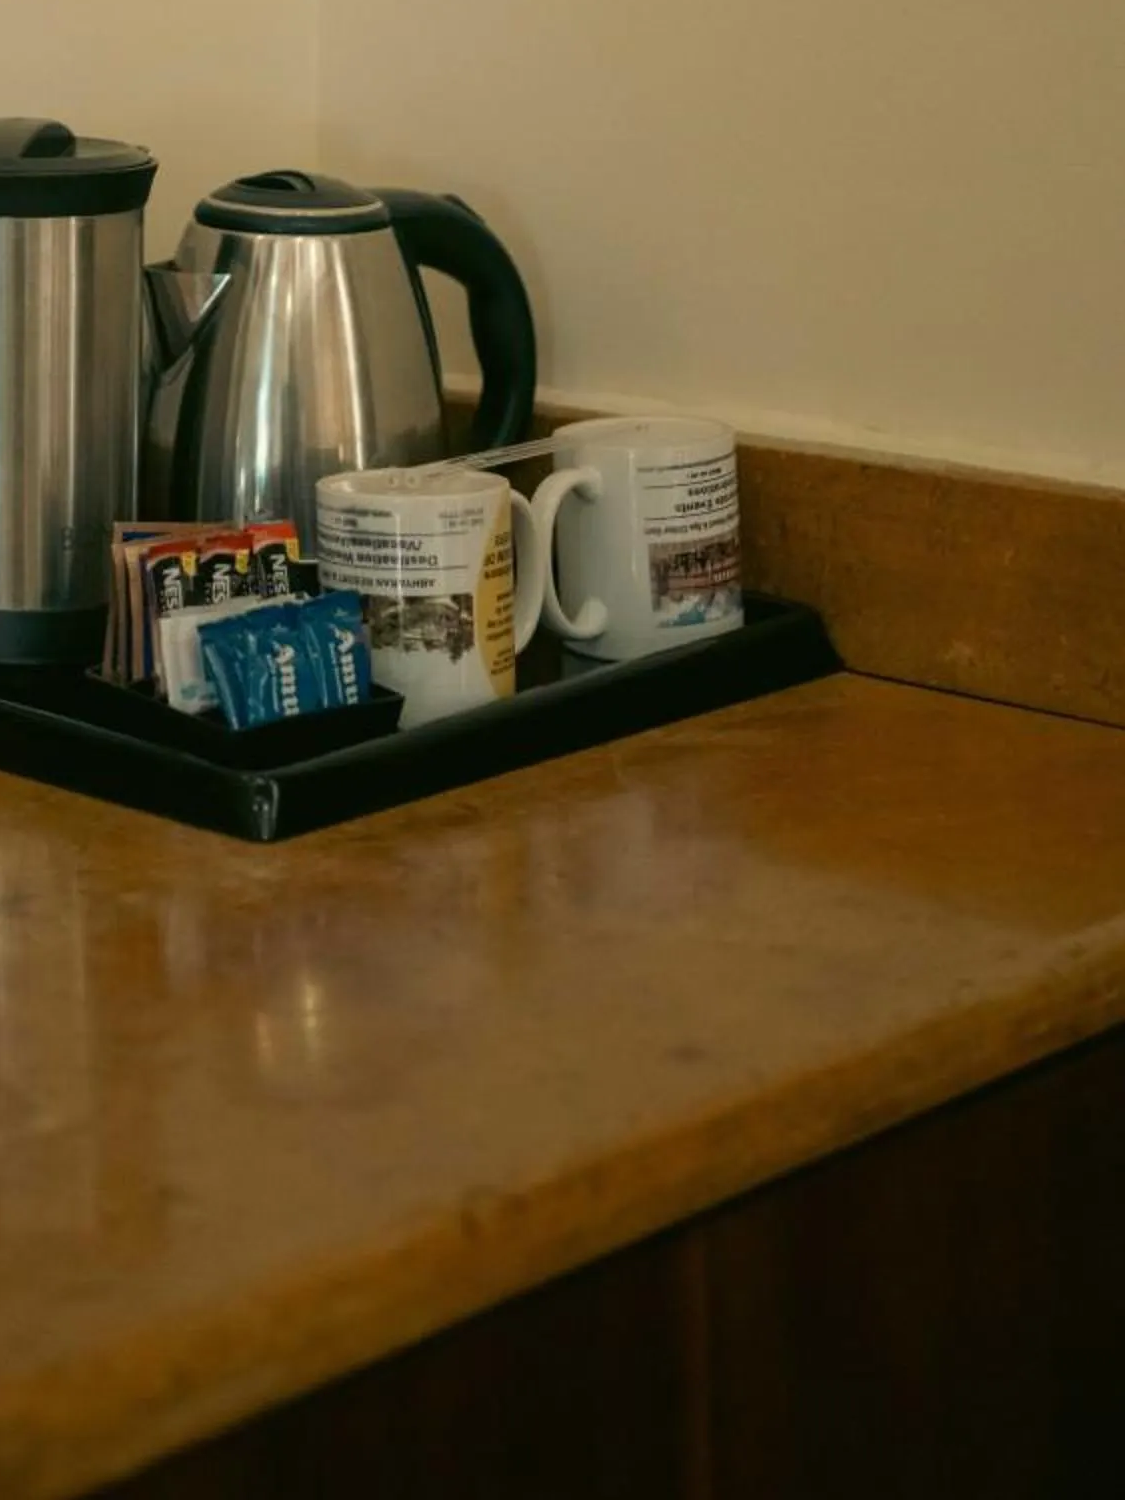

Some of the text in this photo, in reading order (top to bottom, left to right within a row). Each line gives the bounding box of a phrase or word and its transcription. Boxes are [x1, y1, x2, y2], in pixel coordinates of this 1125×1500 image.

[162, 567, 183, 610] NES
[213, 563, 231, 604] NES
[271, 553, 290, 595] NES
[272, 641, 301, 717] Amu
[329, 624, 359, 706] Amu
